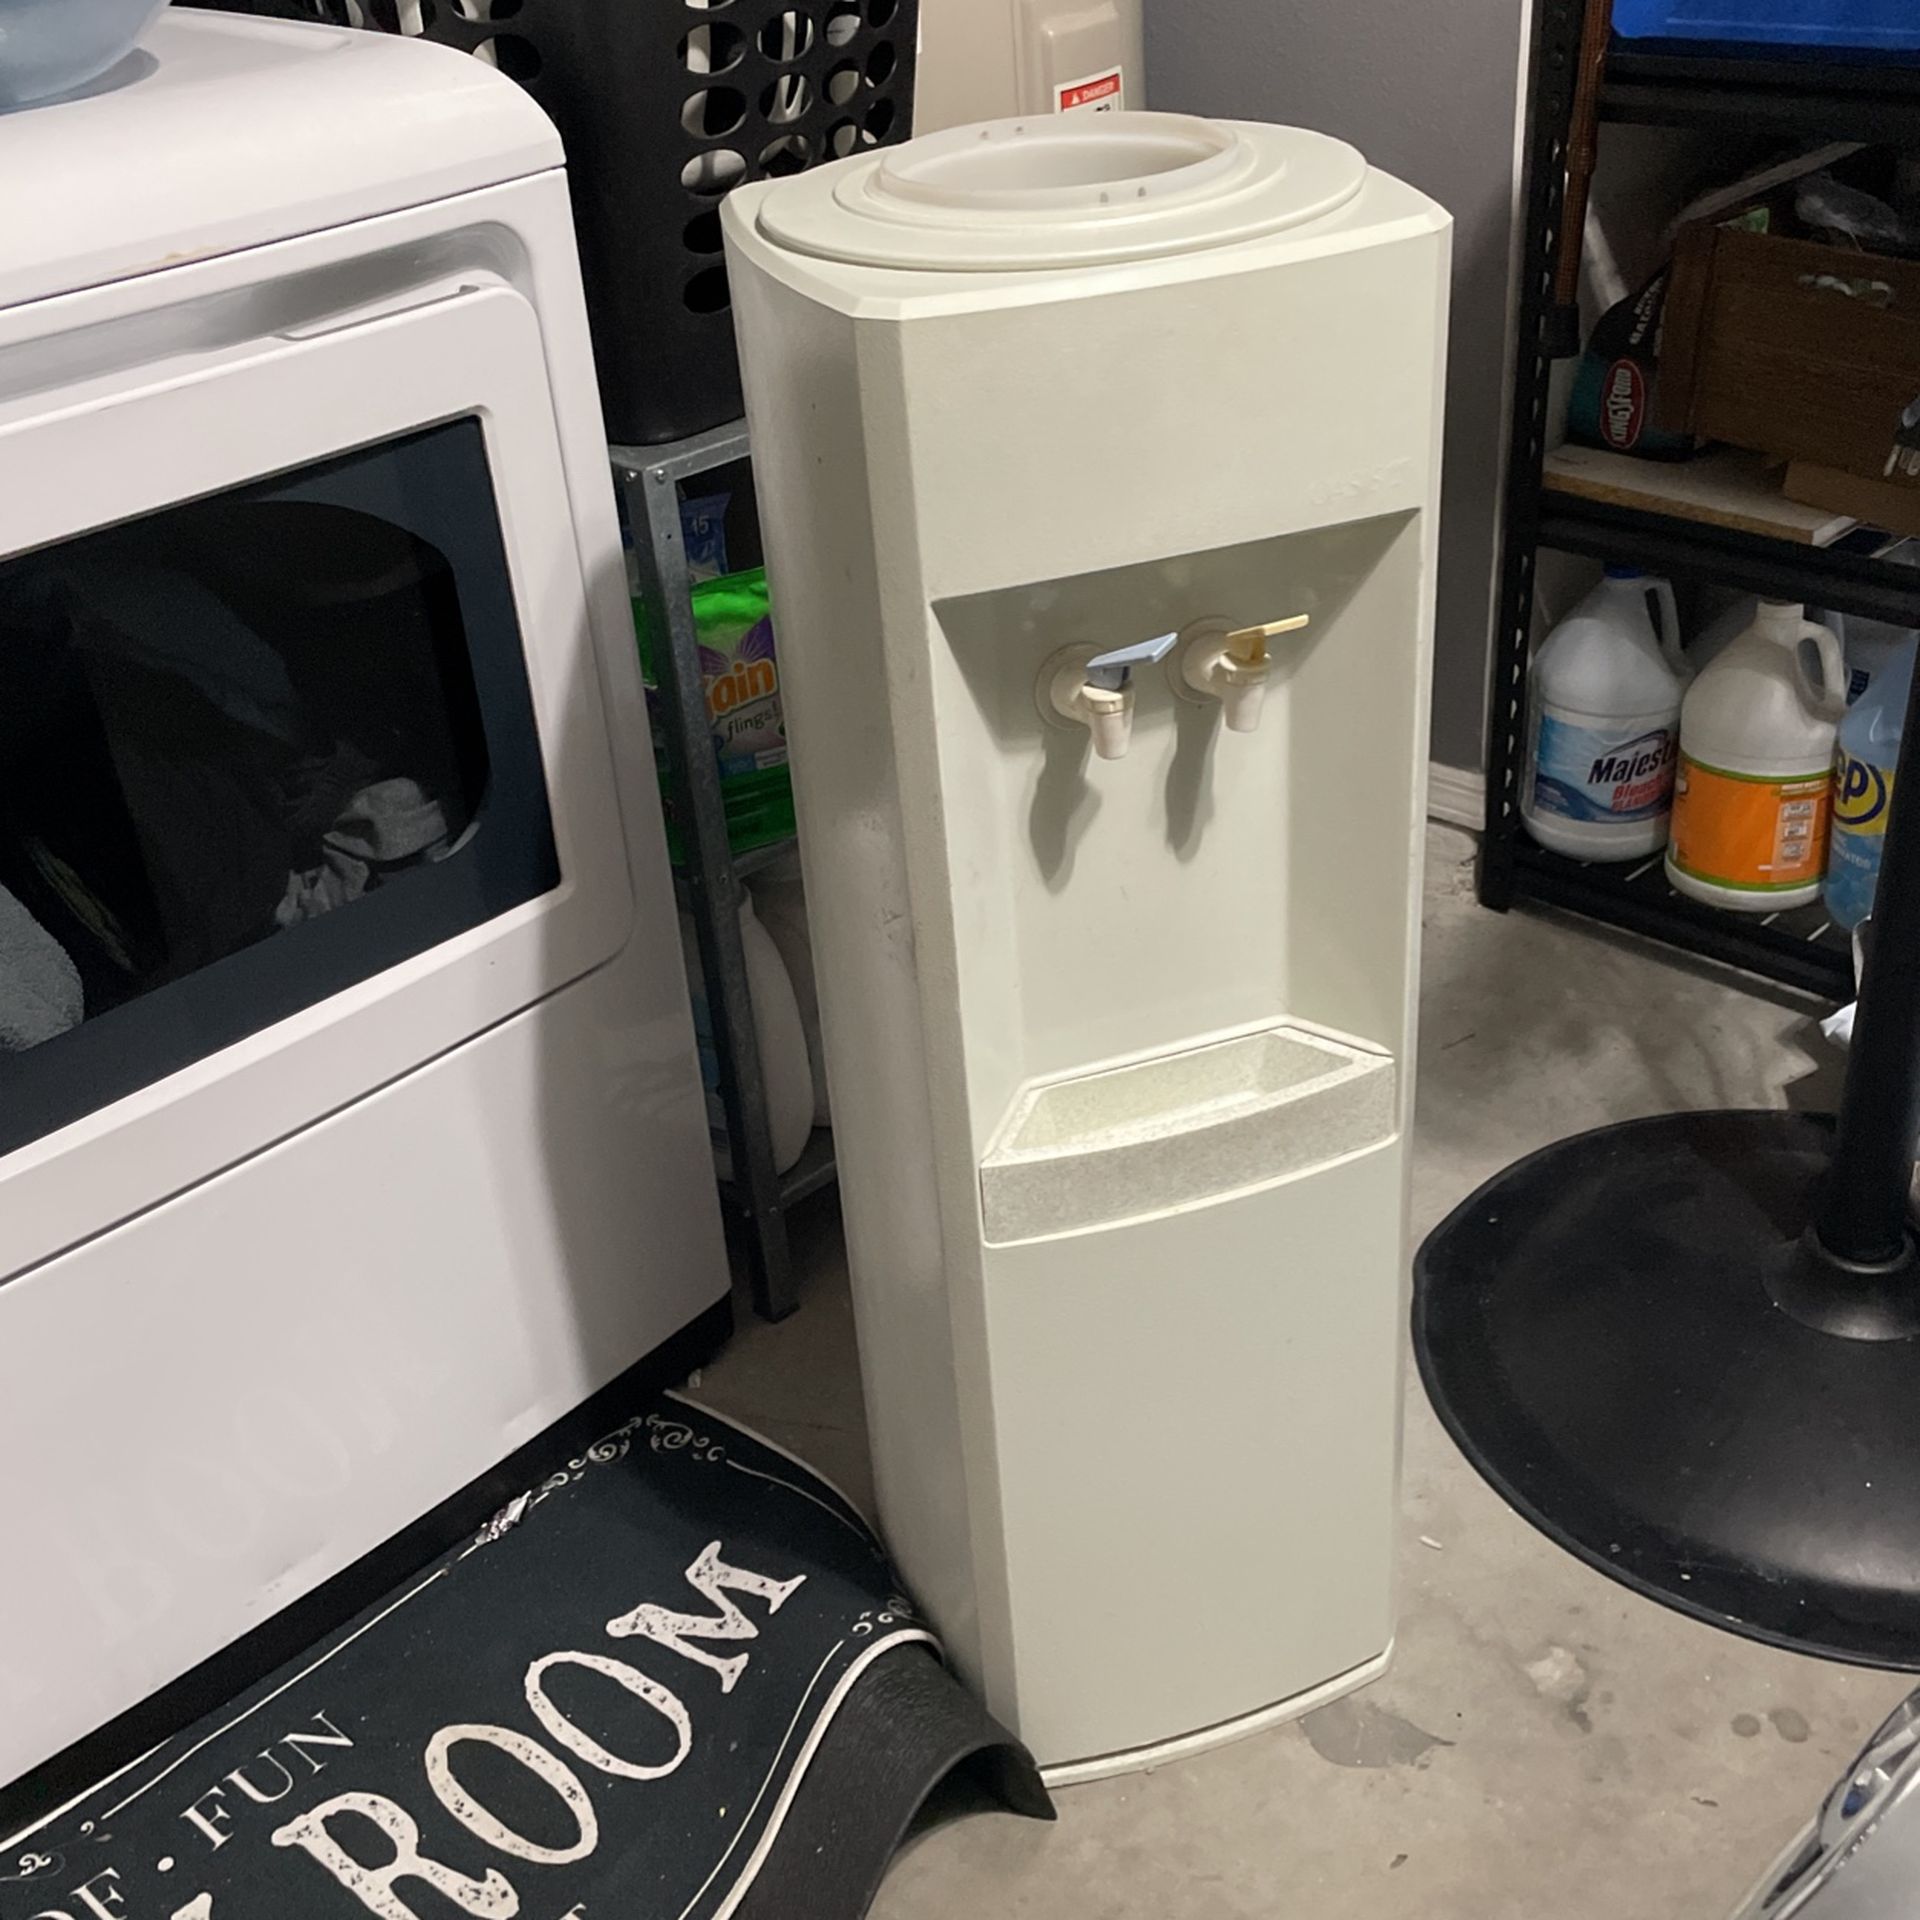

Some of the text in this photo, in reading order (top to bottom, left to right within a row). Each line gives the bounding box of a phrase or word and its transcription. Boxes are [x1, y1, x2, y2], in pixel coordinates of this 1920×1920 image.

[1606, 368, 1634, 442] KINGSFORD
[704, 659, 777, 720] ain
[271, 1540, 807, 1920] ROOM
[27, 1709, 354, 1920] F FUN
